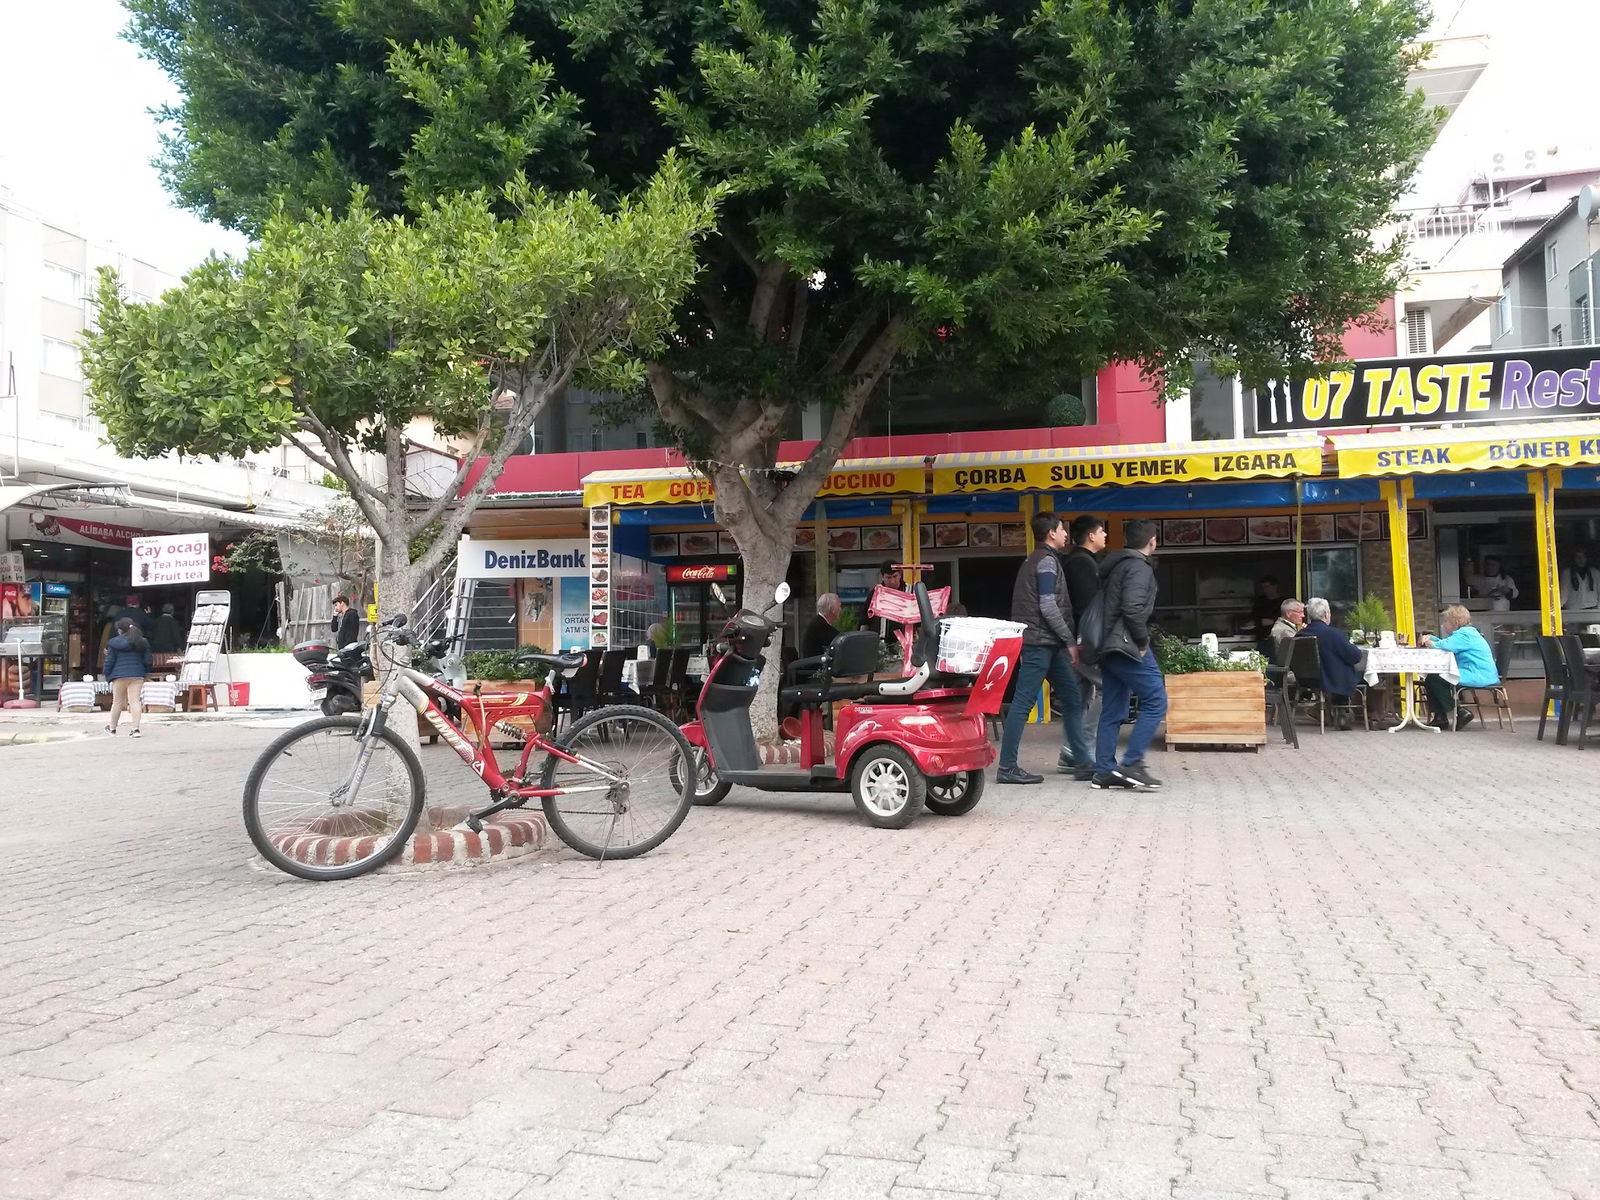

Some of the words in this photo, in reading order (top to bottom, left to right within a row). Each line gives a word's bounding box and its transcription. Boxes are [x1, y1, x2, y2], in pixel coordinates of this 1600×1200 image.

[1301, 370, 1355, 421] 07
[1363, 361, 1494, 418] TASTE
[1378, 447, 1451, 468] STEAK
[1489, 440, 1570, 461] DÖNER
[1580, 438, 1600, 457] K
[955, 468, 1027, 489] ÇORBA
[1051, 463, 1104, 481] SULU
[1112, 459, 1188, 478] YEMEK
[1213, 453, 1297, 473] IZGARA
[611, 484, 645, 499] TEA
[135, 545, 161, 561] Çay
[484, 549, 586, 569] DenizBank
[153, 561, 171, 570] Tea
[175, 558, 207, 568] hause
[154, 572, 181, 582] Fruit
[185, 571, 203, 579] tea
[564, 616, 590, 625] ORTAK
